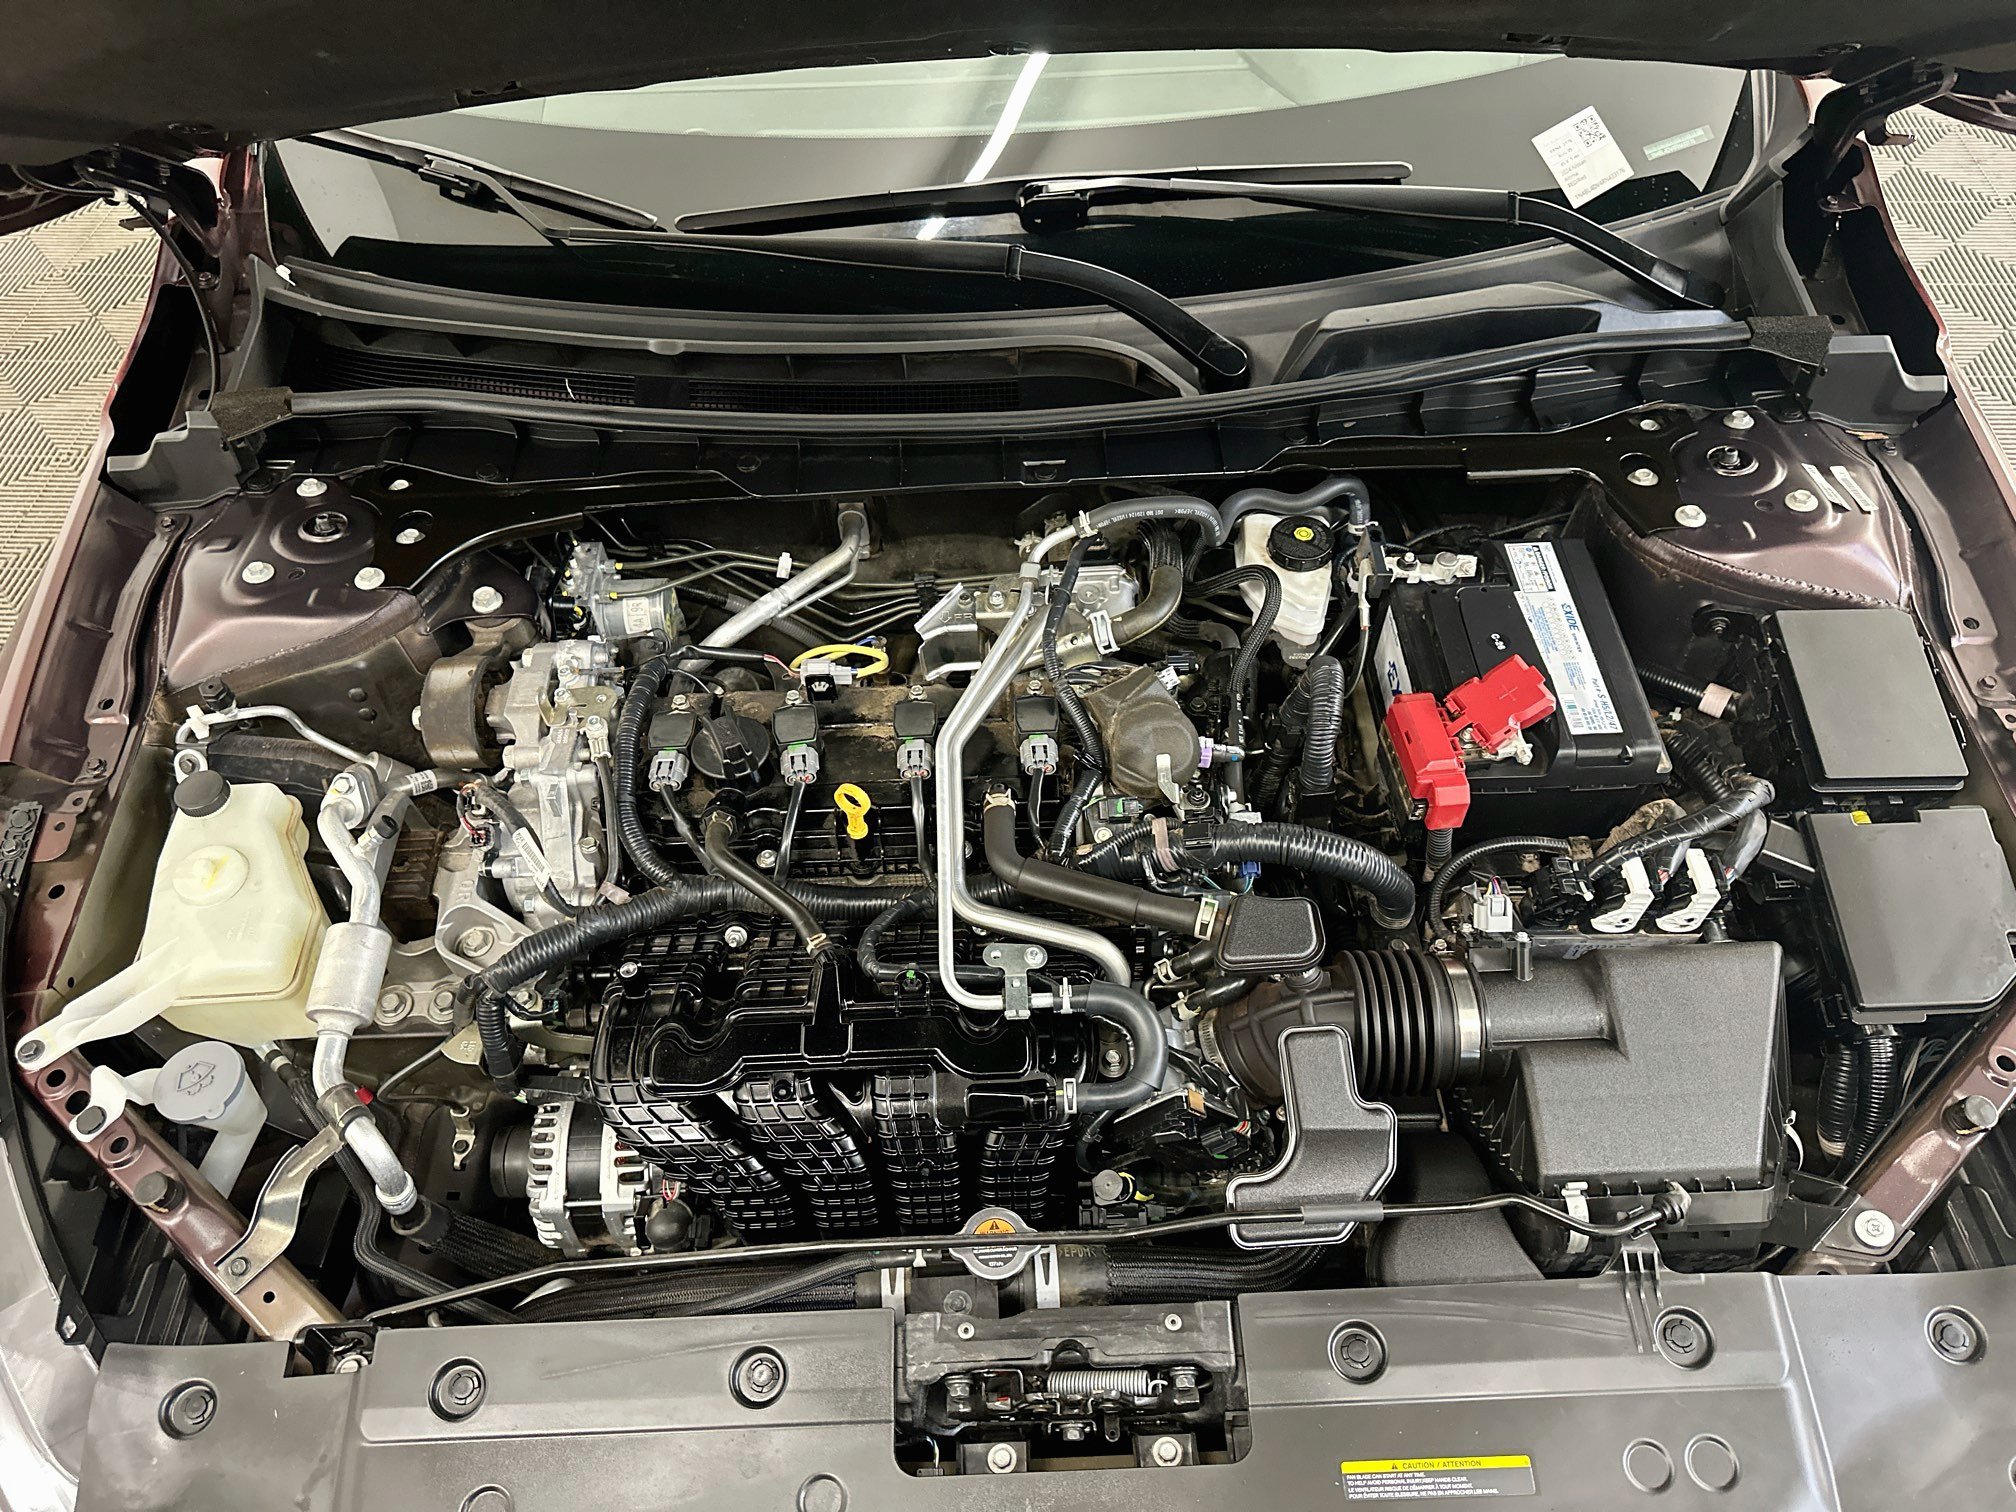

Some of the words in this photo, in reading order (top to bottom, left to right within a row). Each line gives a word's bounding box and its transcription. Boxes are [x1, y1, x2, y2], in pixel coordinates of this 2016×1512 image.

[1561, 602, 1579, 632] EXIDE
[1402, 1462, 1435, 1470] CAUTION
[1442, 1460, 1482, 1468] ATTENTION
